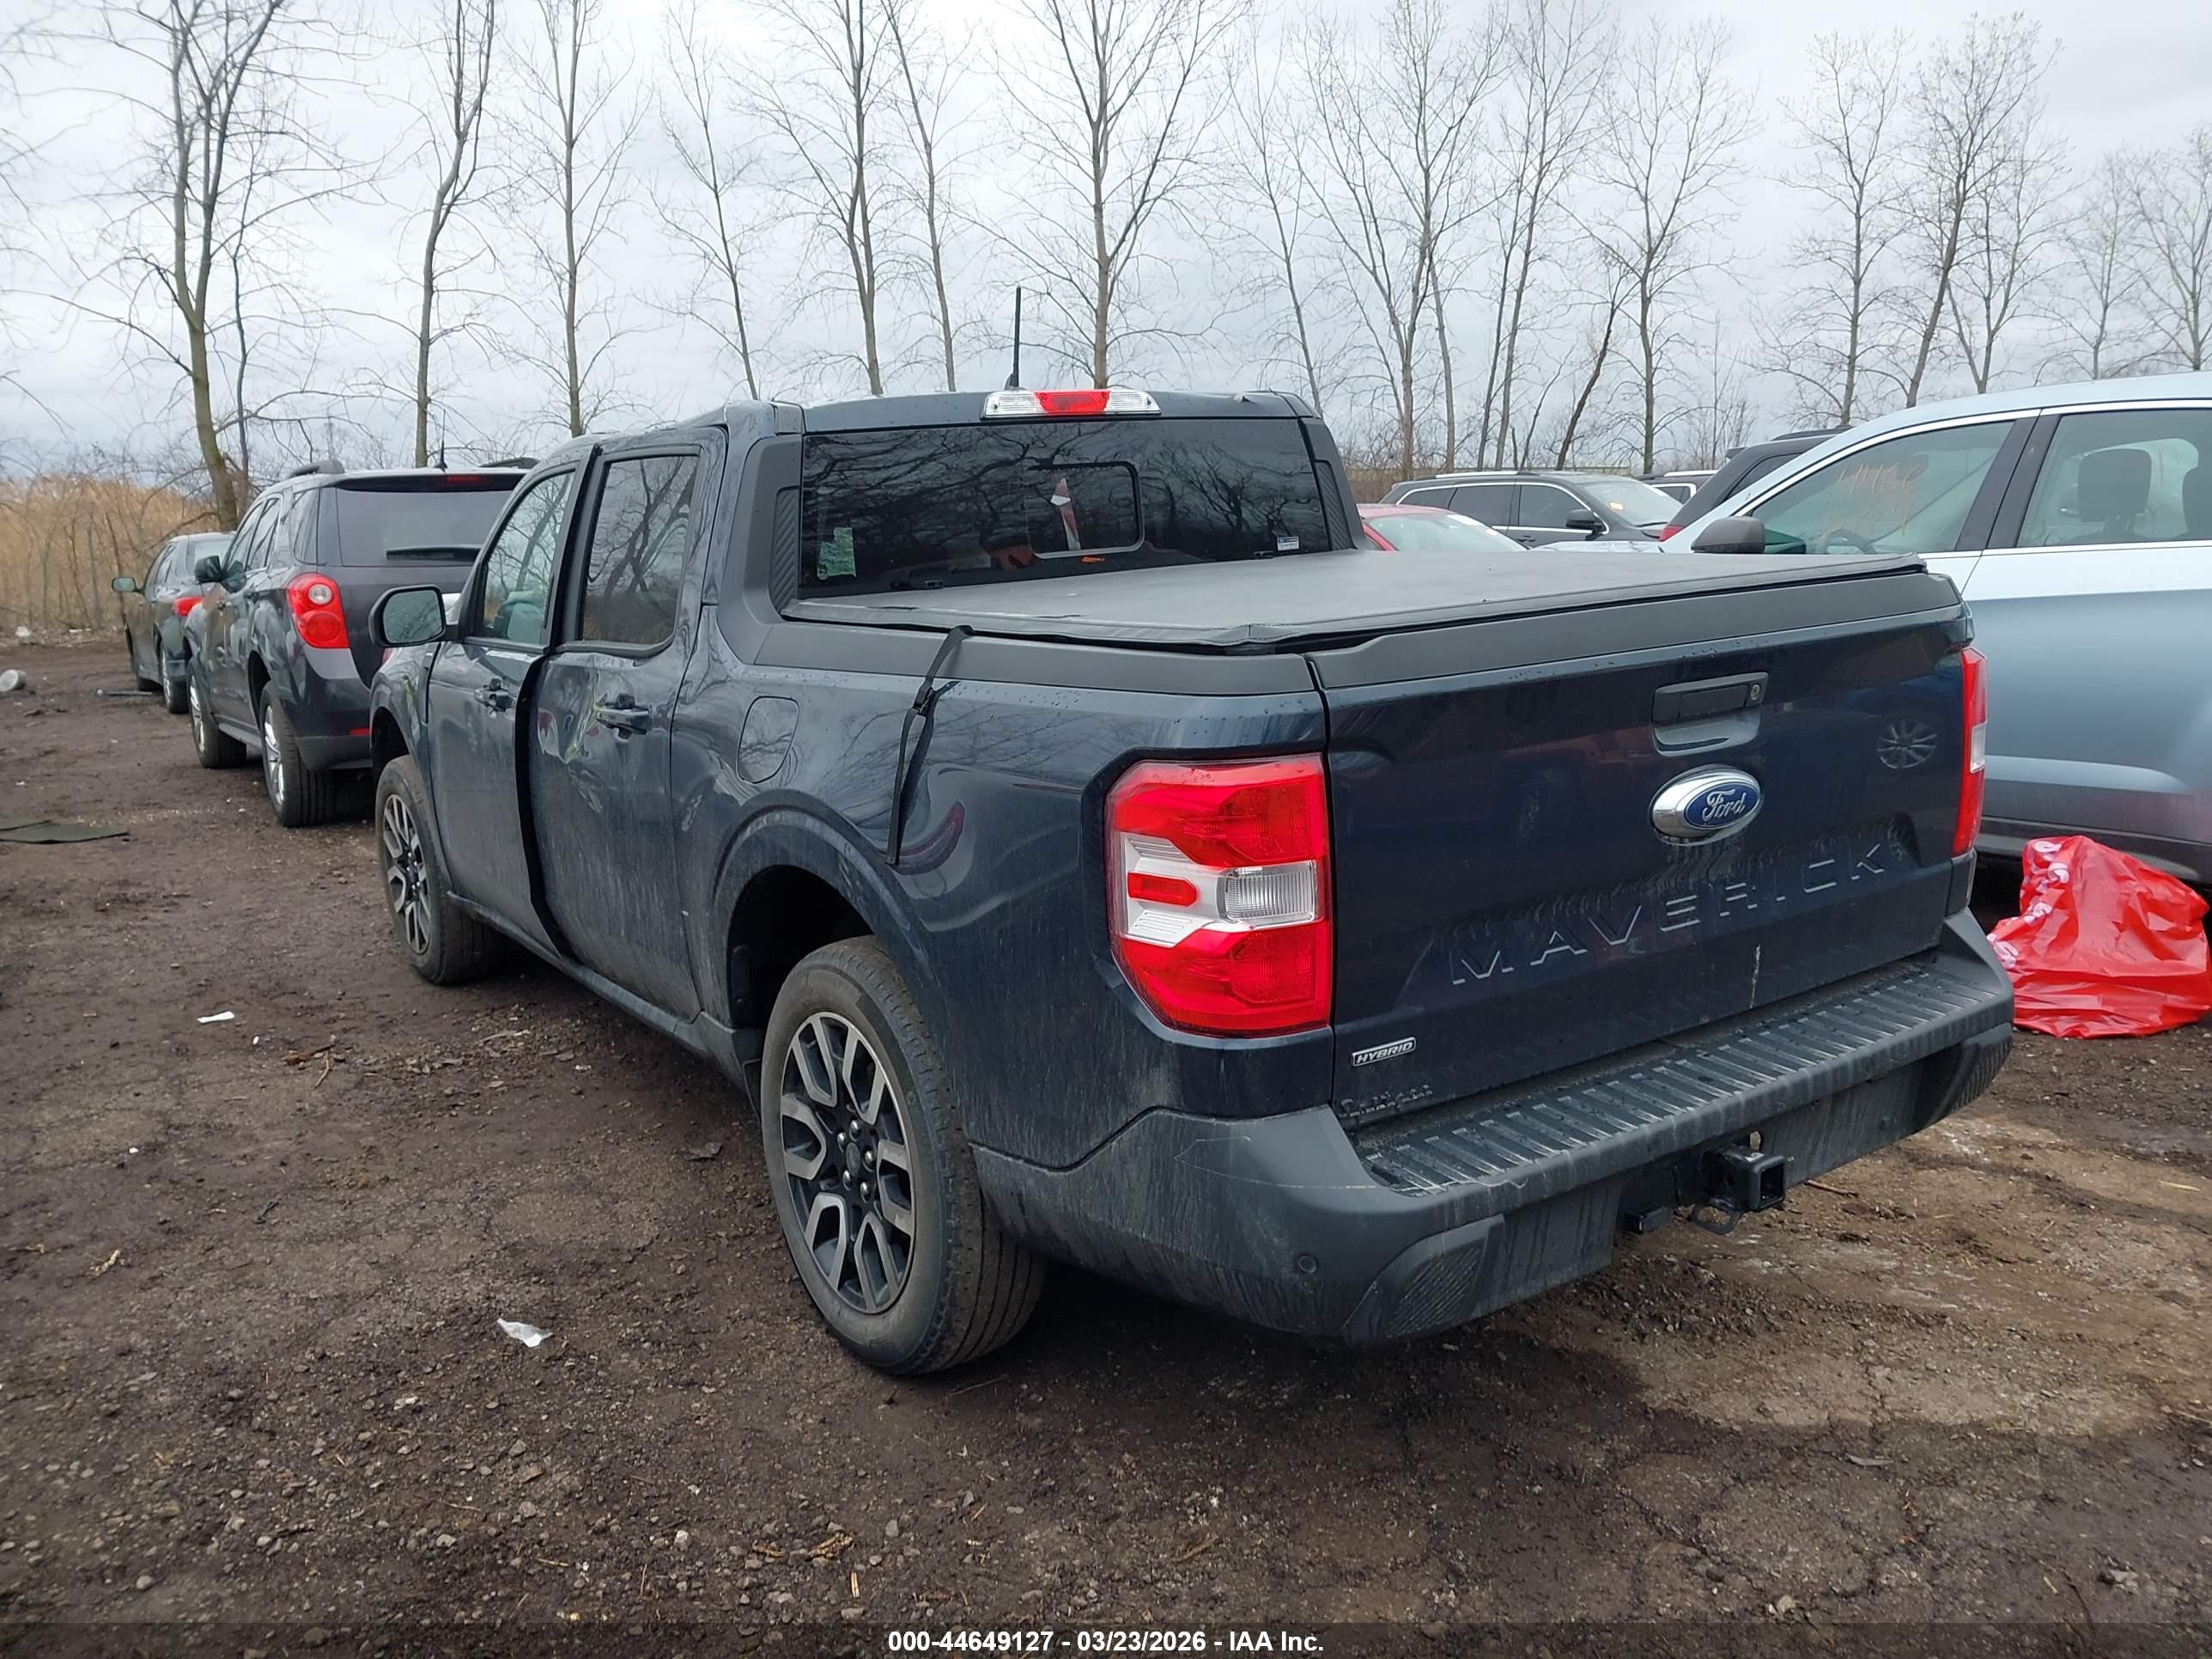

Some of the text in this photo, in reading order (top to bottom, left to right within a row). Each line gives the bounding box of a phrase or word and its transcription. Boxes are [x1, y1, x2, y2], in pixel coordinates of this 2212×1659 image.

[1701, 788, 1747, 822] Ford
[1449, 842, 1885, 986] MAVERICK
[1355, 1040, 1413, 1065] HYBRID
